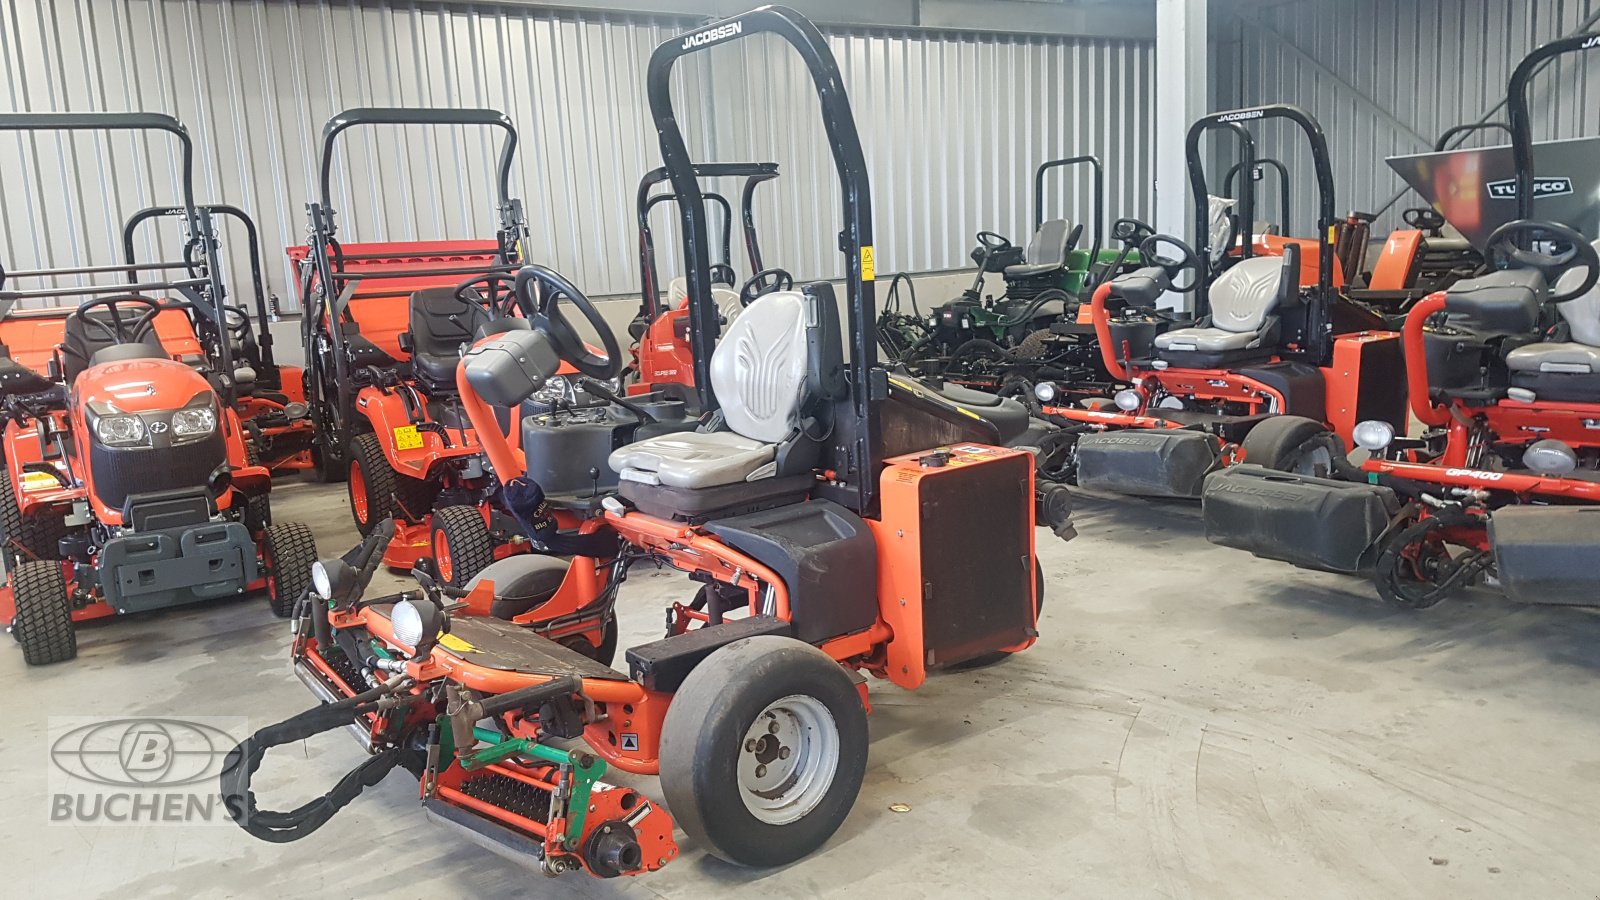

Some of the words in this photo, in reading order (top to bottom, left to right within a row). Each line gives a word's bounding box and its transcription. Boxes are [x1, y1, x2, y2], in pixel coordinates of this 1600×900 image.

[682, 21, 742, 50] JACOBSEN
[1217, 110, 1264, 122] JACOBSEN
[1494, 181, 1565, 194] TUFCO
[1446, 468, 1504, 480] GP400
